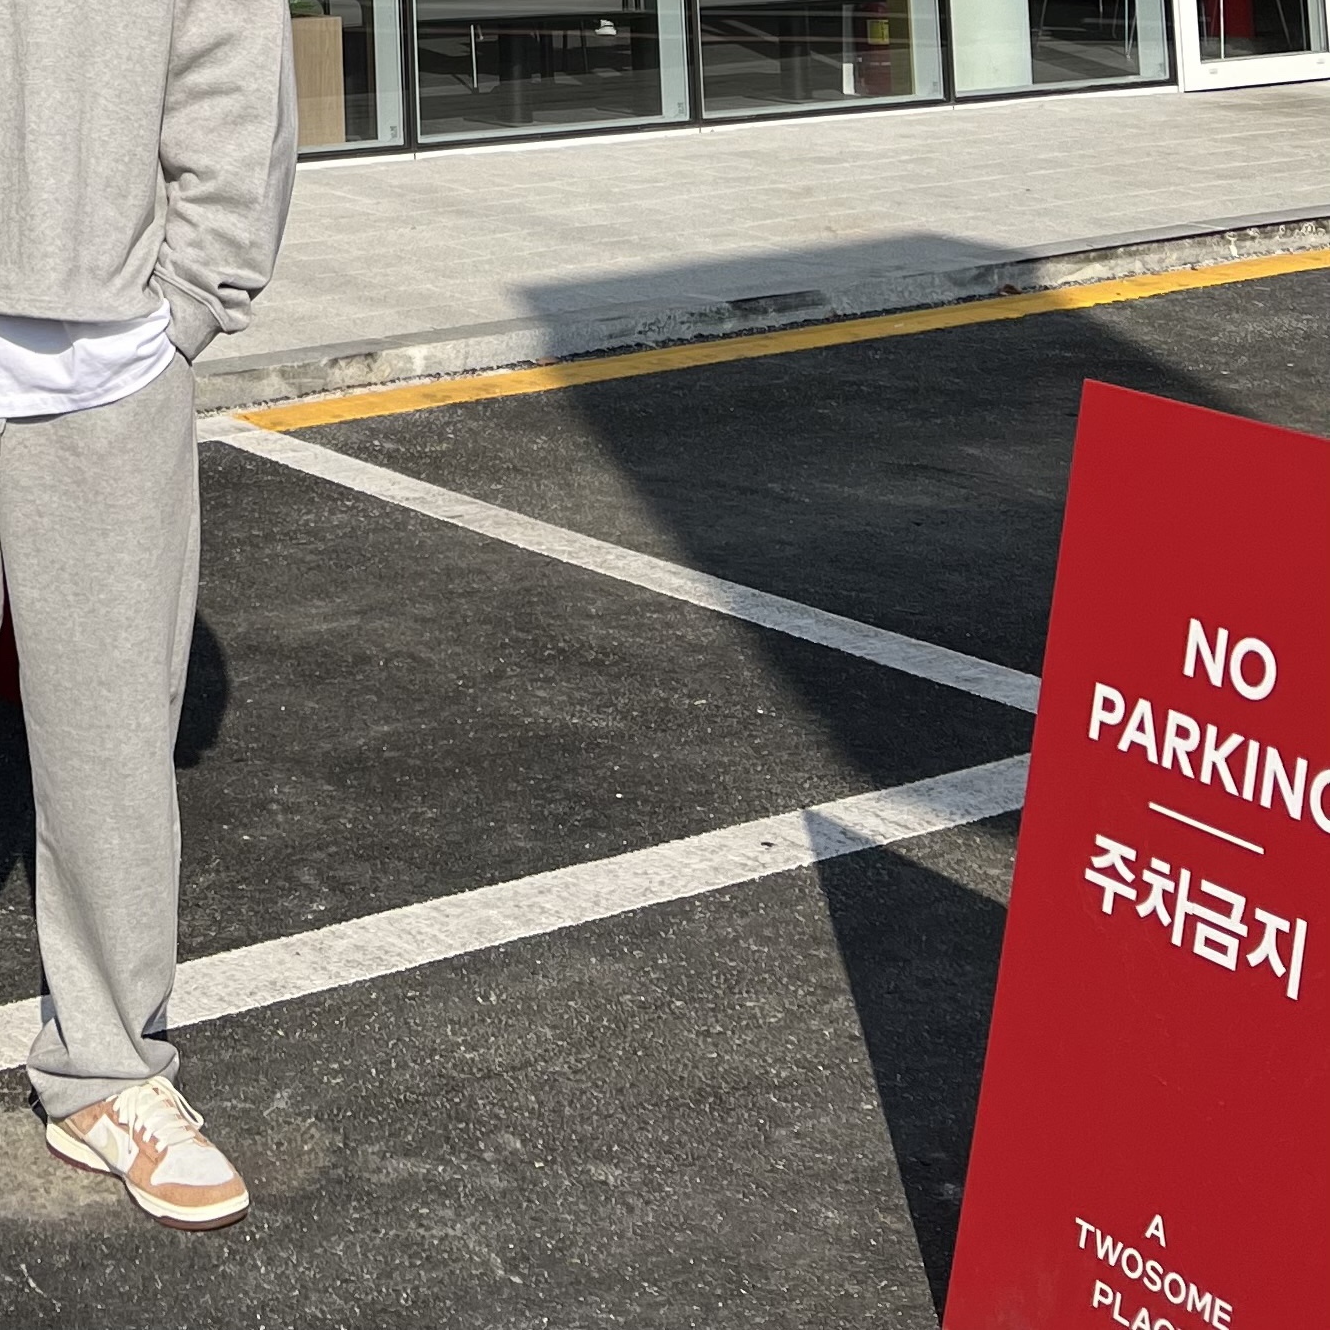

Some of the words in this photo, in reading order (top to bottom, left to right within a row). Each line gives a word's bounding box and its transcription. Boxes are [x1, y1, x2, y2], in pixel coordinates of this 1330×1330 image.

[1182, 617, 1277, 701] NO
[1084, 833, 1308, 1001] 주차금지
[1075, 1216, 1233, 1330] TWOSOME
[1144, 1214, 1167, 1248] A
